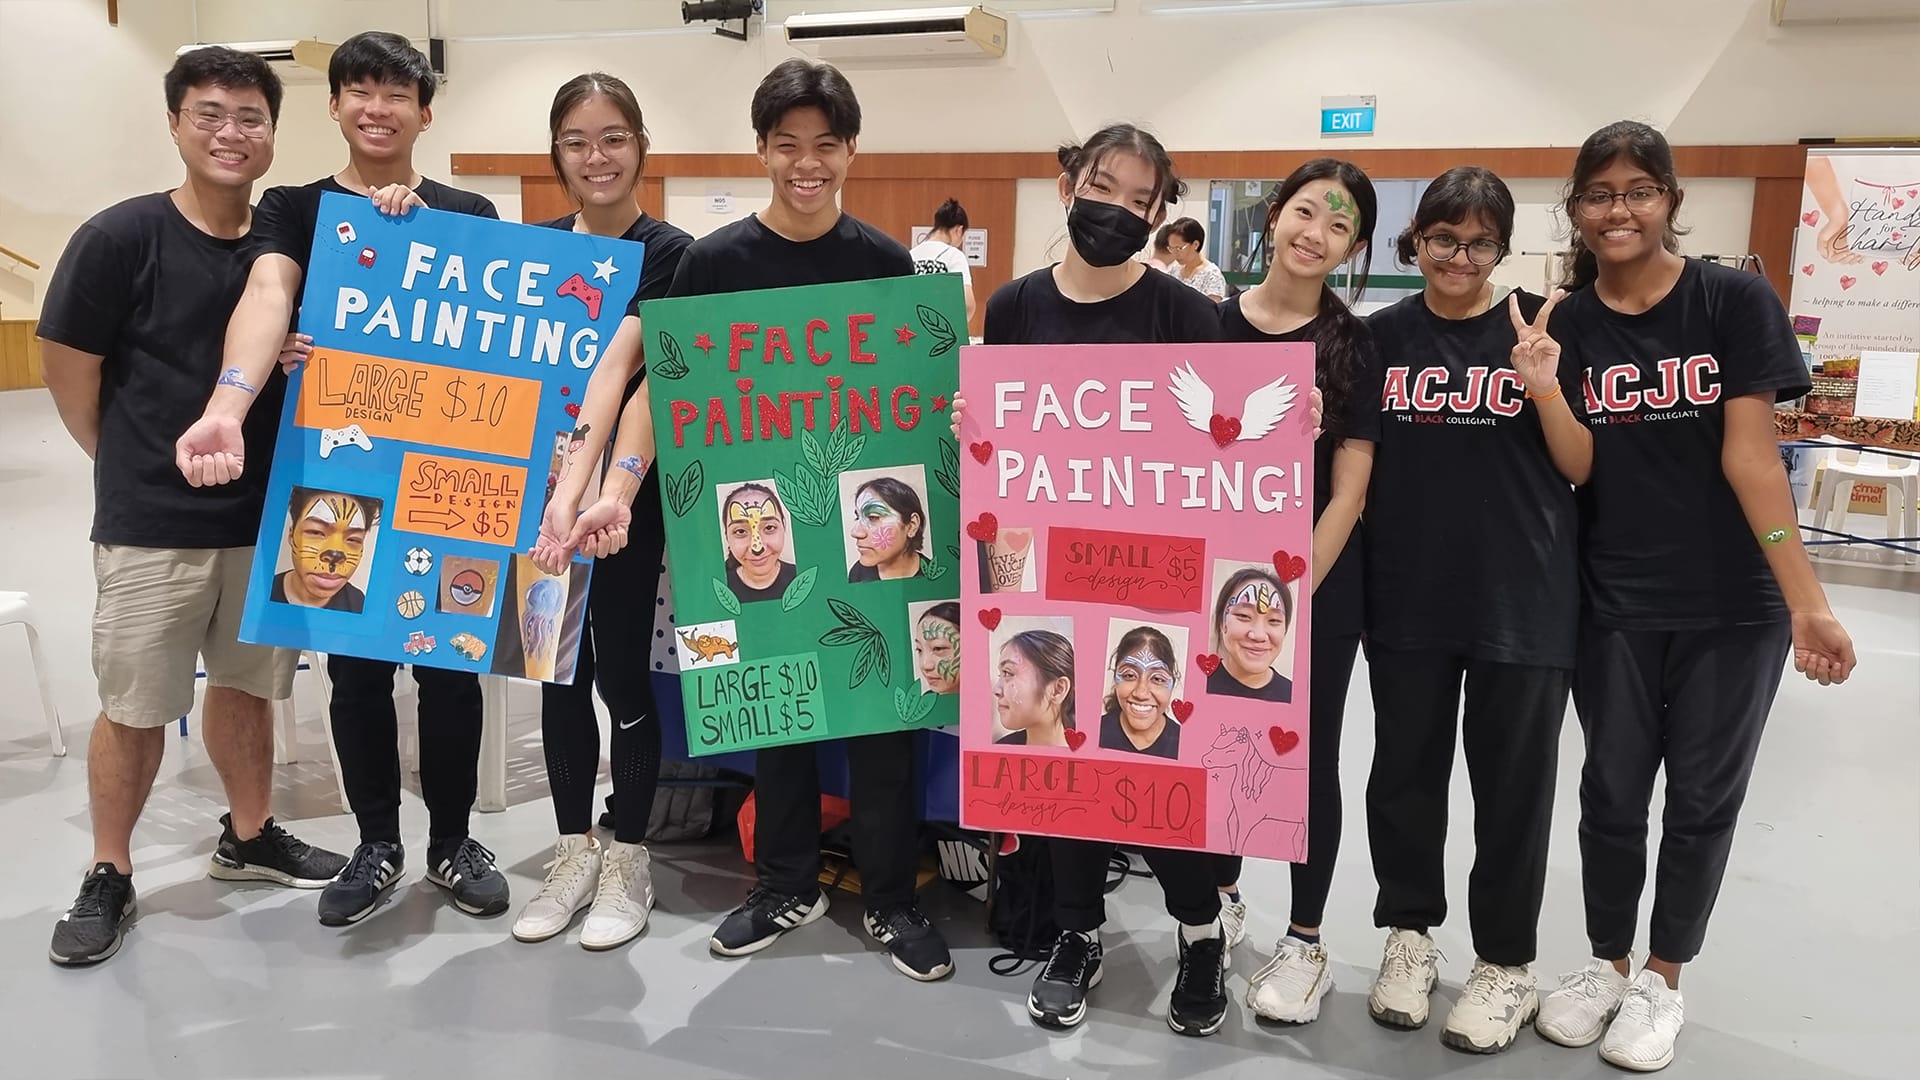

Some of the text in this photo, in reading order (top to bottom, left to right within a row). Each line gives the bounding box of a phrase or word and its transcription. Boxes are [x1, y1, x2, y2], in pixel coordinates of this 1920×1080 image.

[1332, 112, 1363, 129] EXIT
[1877, 223, 1896, 235] for
[401, 241, 550, 306] FACE
[1812, 297, 1845, 308] helping
[1858, 299, 1881, 307] make
[334, 286, 599, 369] PAINTING
[728, 313, 877, 371] FACE
[1823, 331, 1834, 339] An
[1836, 332, 1872, 340] initiative
[1904, 336, 1914, 344] by
[318, 358, 508, 427] LARGE $10
[995, 380, 1154, 432] FACE
[1381, 366, 1525, 417] ACJC
[345, 407, 393, 423] DESIGN
[1397, 415, 1496, 426] THE BLACK COLLEGIATE
[1590, 410, 1700, 425] THE BLACK COLLEGIATE
[410, 460, 519, 497] SMALL
[997, 450, 1303, 513] PAINTING!
[472, 511, 510, 538] $5
[1065, 542, 1197, 582] SMALL $5
[1065, 568, 1168, 600] design
[697, 660, 818, 710] LARGE $10
[700, 699, 815, 746] SMALL $5
[969, 792, 1087, 826] design
[972, 756, 1192, 831] LARGE $10
[937, 840, 989, 881] NIK
